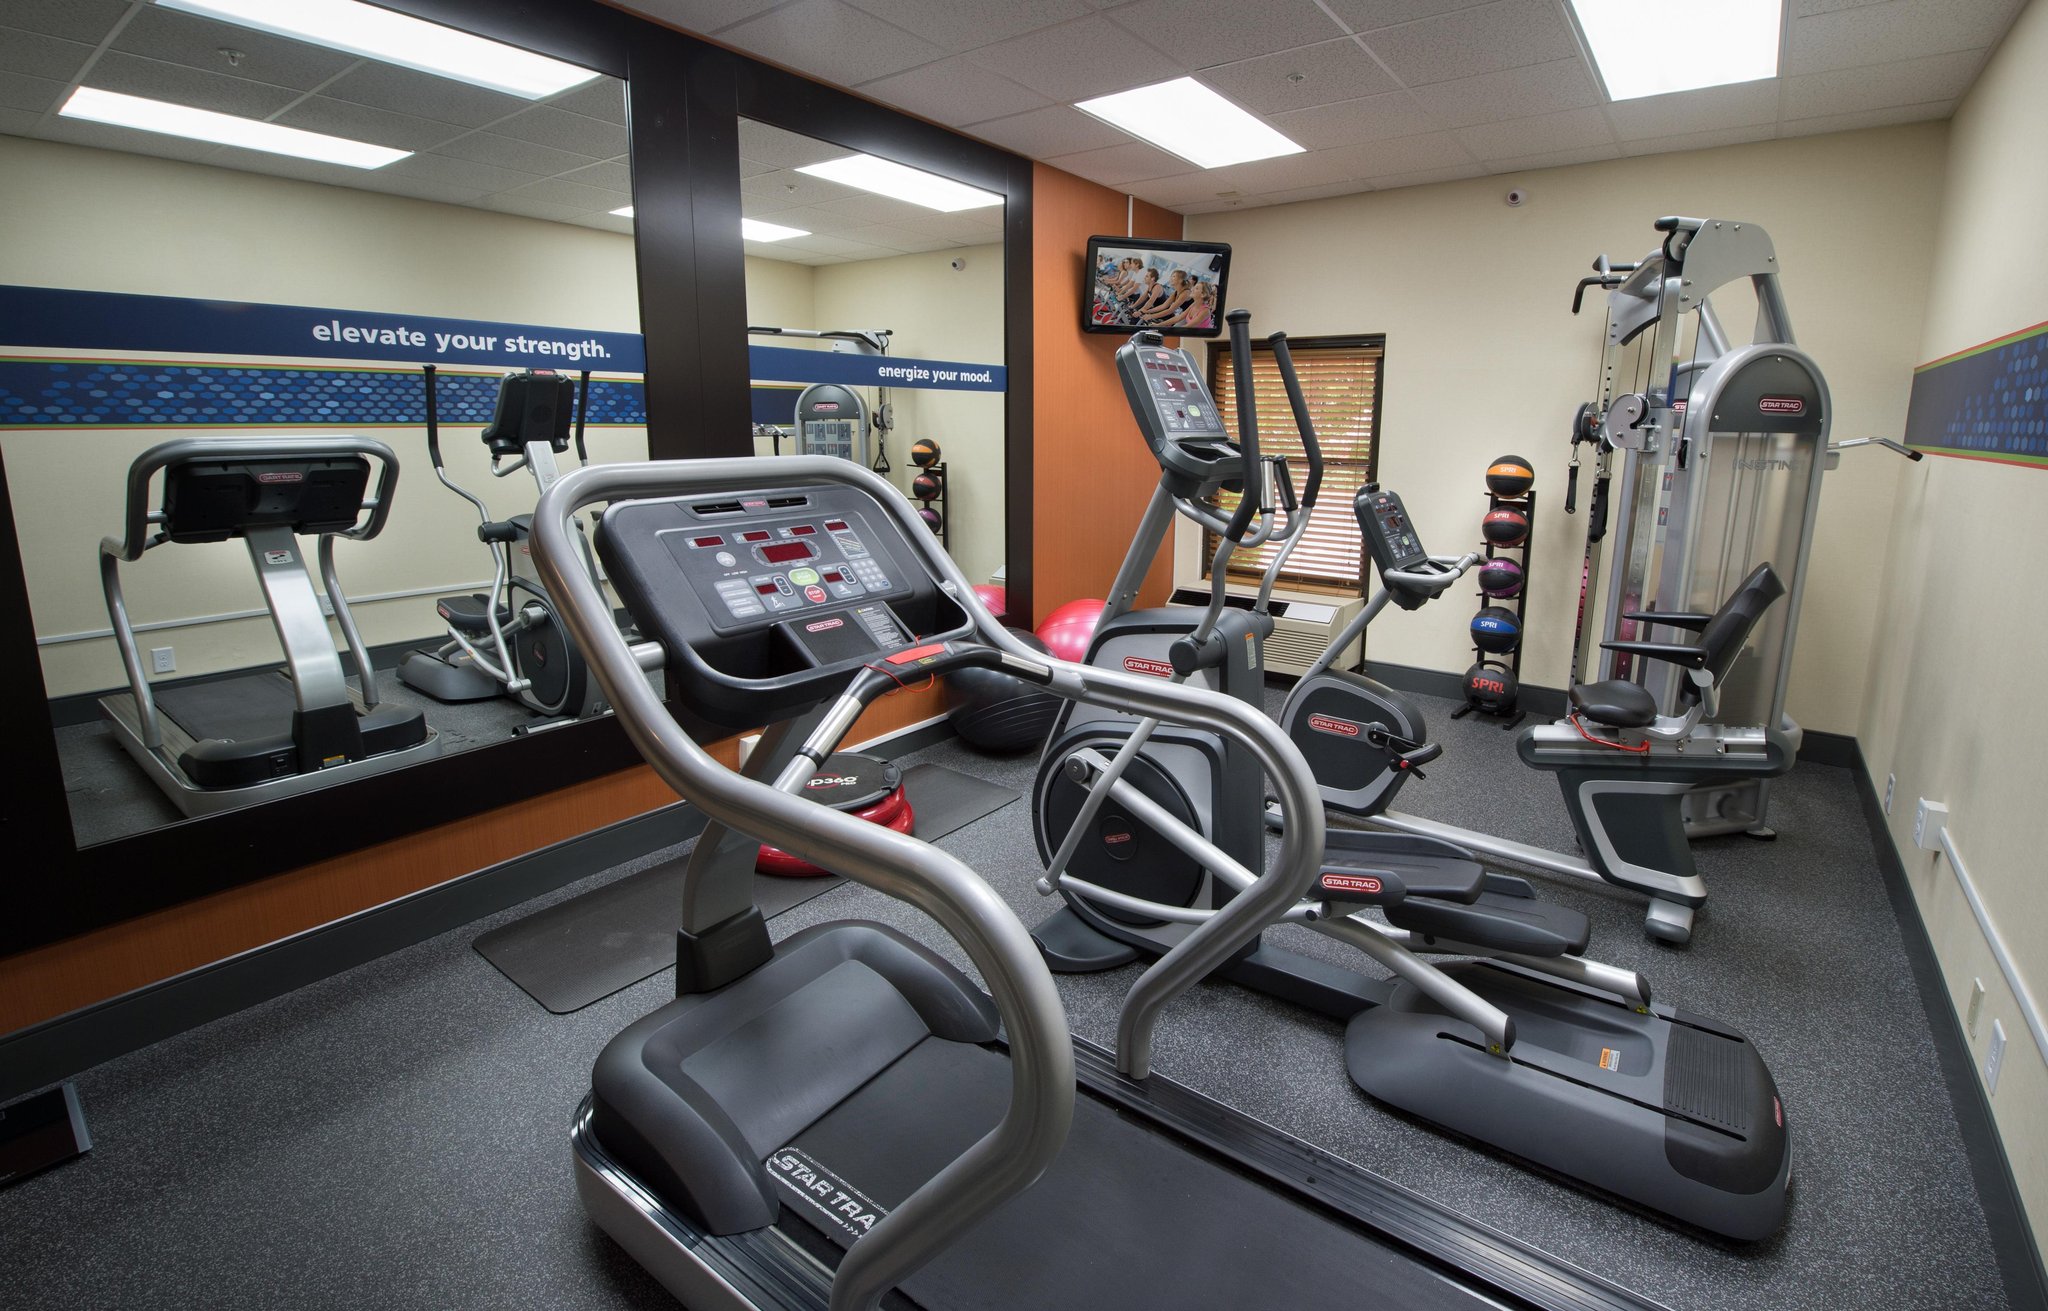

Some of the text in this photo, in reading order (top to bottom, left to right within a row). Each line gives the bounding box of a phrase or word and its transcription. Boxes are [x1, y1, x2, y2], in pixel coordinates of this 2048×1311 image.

[312, 320, 611, 361] elevate your strength.
[878, 366, 992, 383] energize your mood.
[1732, 459, 1797, 470] INSTIN
[825, 620, 841, 628] TRAC
[1480, 620, 1498, 629] SPRI
[1127, 661, 1150, 670] STAR
[1313, 720, 1355, 733] STAR TRAC
[806, 776, 857, 786] p360
[1326, 878, 1376, 889] STAR TRAC
[779, 1155, 876, 1231] STAR TRA
